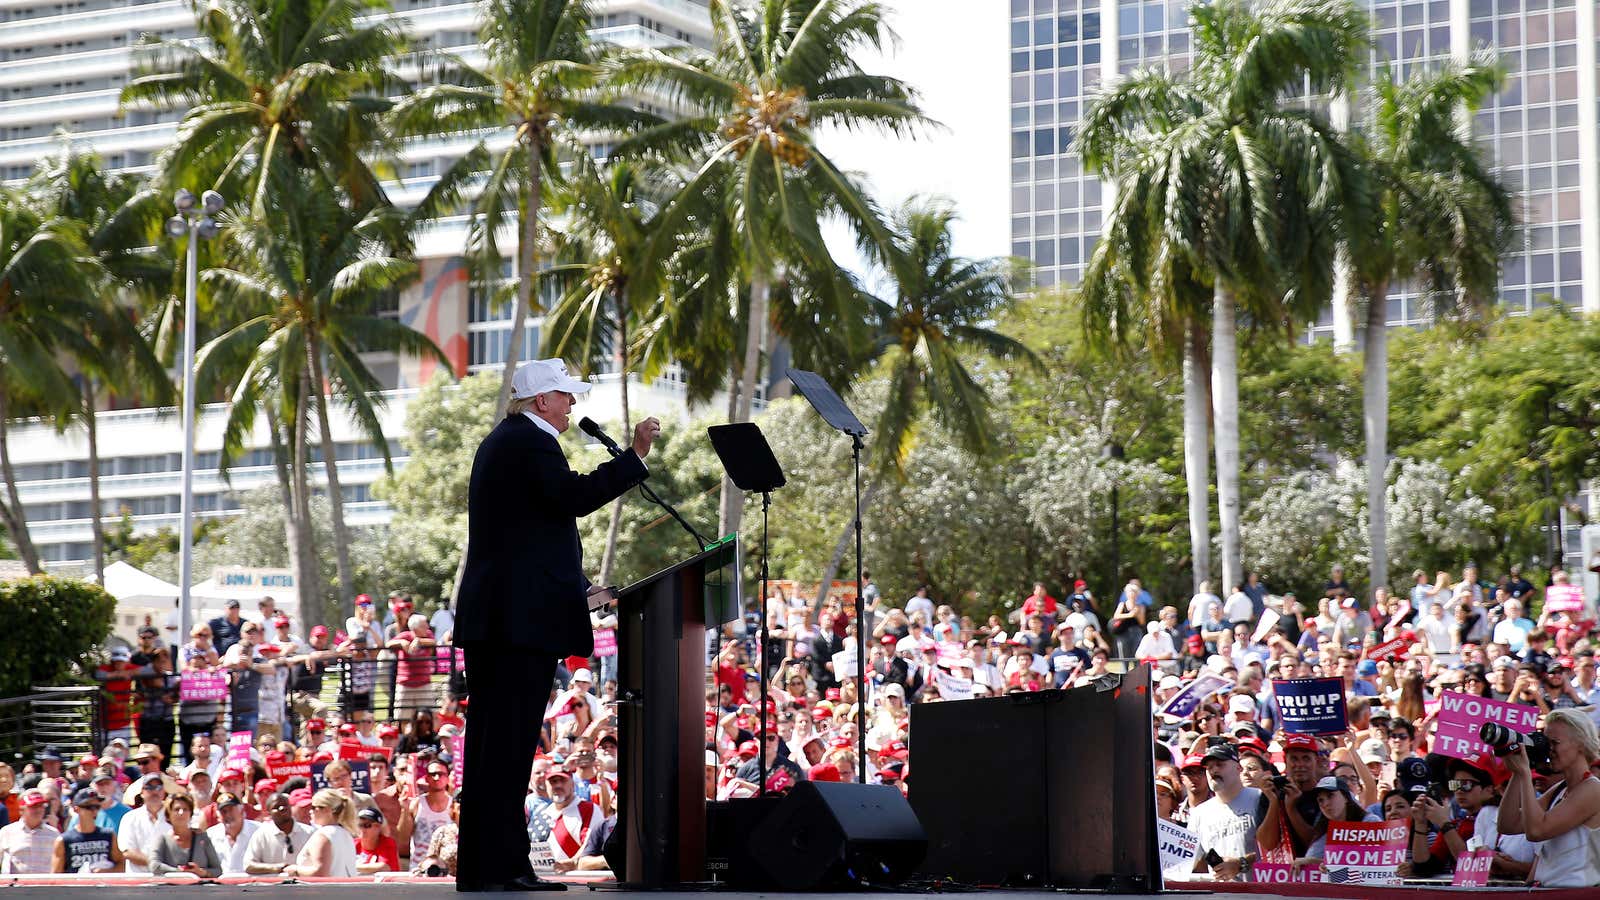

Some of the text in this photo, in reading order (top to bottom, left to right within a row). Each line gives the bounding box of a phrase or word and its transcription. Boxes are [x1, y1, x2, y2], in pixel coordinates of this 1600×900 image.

[1276, 693, 1341, 708] TRUMP
[1281, 706, 1335, 717] PENCE
[1443, 695, 1538, 728] WOMEN
[1159, 823, 1199, 845] ETERANS
[1332, 825, 1407, 842] HISPANICS
[1325, 849, 1407, 866] WOMEN
[1456, 856, 1494, 872] WOMEN
